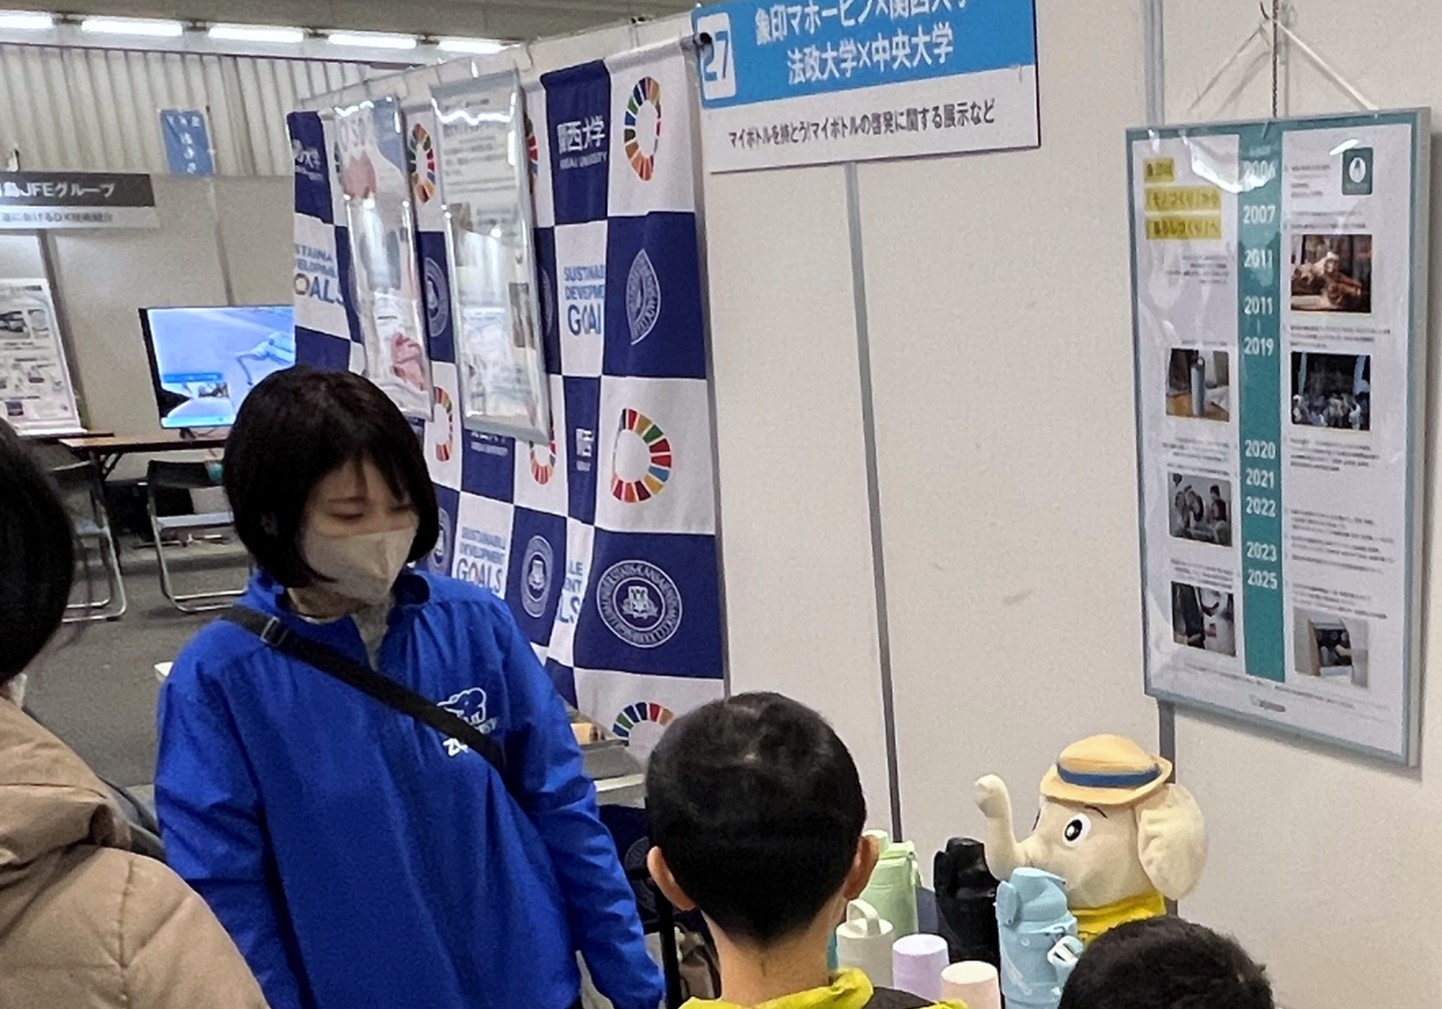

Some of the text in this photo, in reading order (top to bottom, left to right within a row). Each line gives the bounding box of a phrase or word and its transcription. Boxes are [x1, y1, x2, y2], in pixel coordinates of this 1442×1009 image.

[787, 22, 954, 85] 法政大学×中央大学
[1243, 204, 1276, 225] 2007
[1244, 249, 1274, 270] 2011
[1244, 296, 1274, 316] 2011
[1243, 336, 1275, 356] 2019
[1244, 439, 1277, 460] 2020
[1245, 468, 1275, 489] 2021
[1245, 496, 1277, 518] 2022
[1246, 541, 1278, 563] 2023
[1247, 569, 1278, 590] 2025
